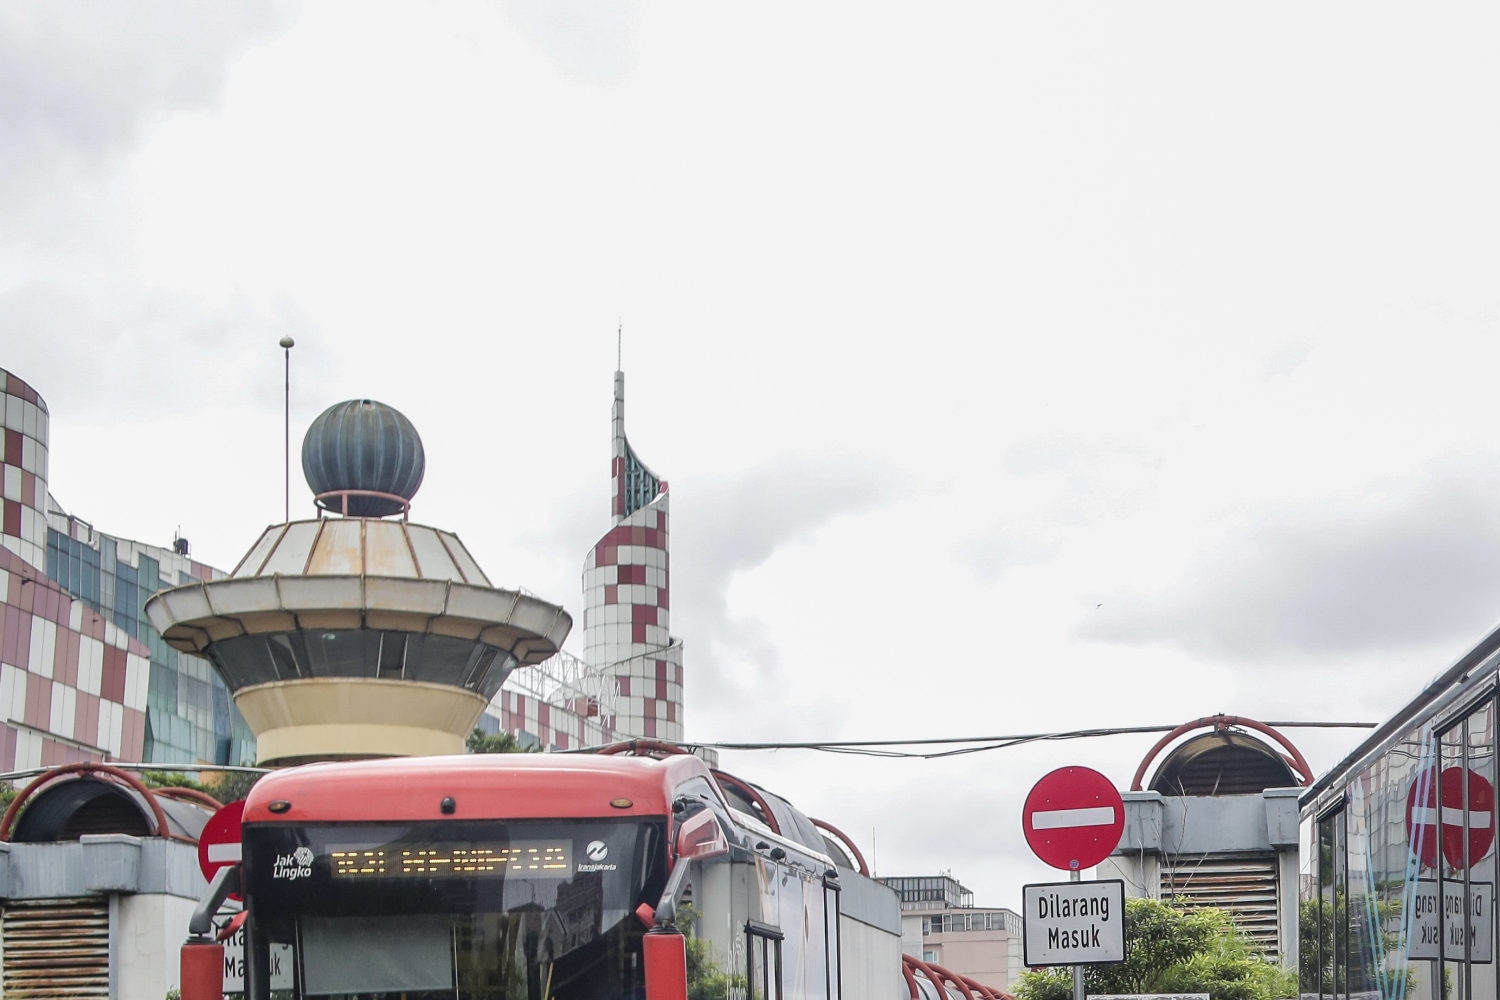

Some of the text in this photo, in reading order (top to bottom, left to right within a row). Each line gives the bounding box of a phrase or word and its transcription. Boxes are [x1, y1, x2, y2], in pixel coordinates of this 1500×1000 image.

[273, 854, 294, 867] Jak
[273, 866, 312, 880] Lingko
[577, 864, 617, 872] transjakarta
[1038, 893, 1109, 922] Dilarang
[1048, 923, 1101, 950] Masuk
